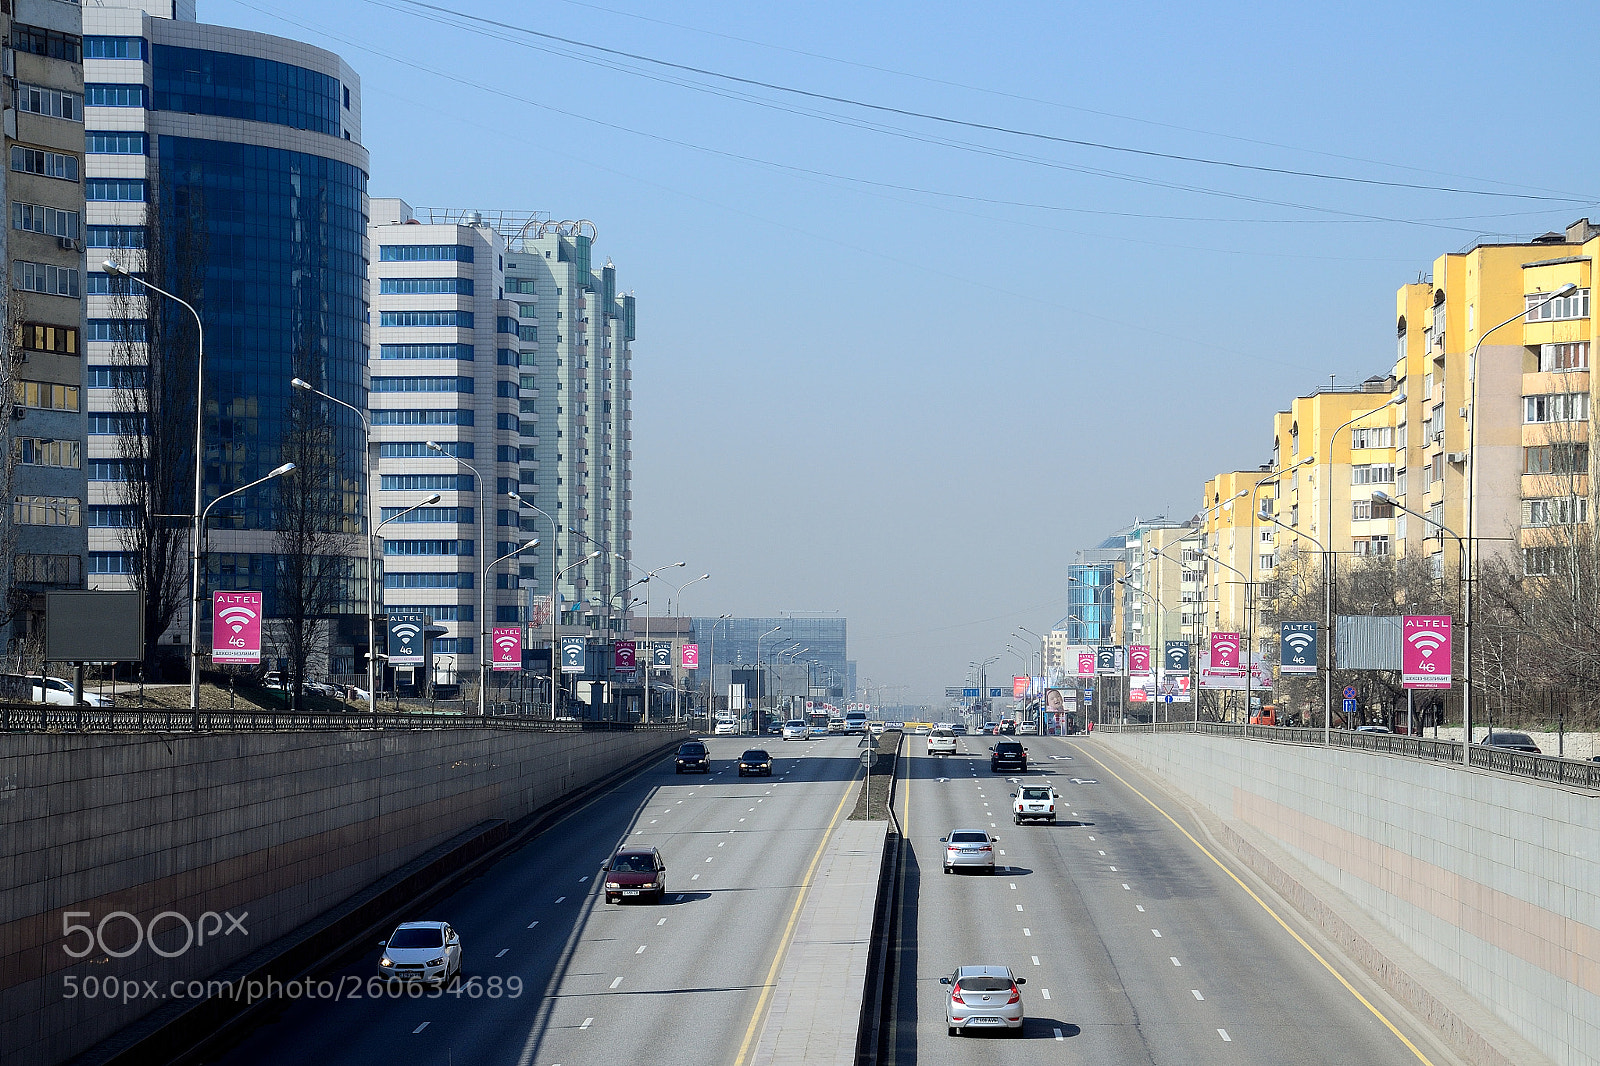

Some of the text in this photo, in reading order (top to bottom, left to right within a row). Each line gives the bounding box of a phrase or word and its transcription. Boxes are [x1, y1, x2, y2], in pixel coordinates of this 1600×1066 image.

[216, 595, 259, 604] ALTEL
[1406, 620, 1448, 628] ALTEL
[228, 635, 246, 648] 4G
[400, 646, 412, 655] 4G
[1220, 658, 1230, 667] 4G
[1292, 655, 1306, 665] 4G
[1418, 660, 1436, 672] 4G
